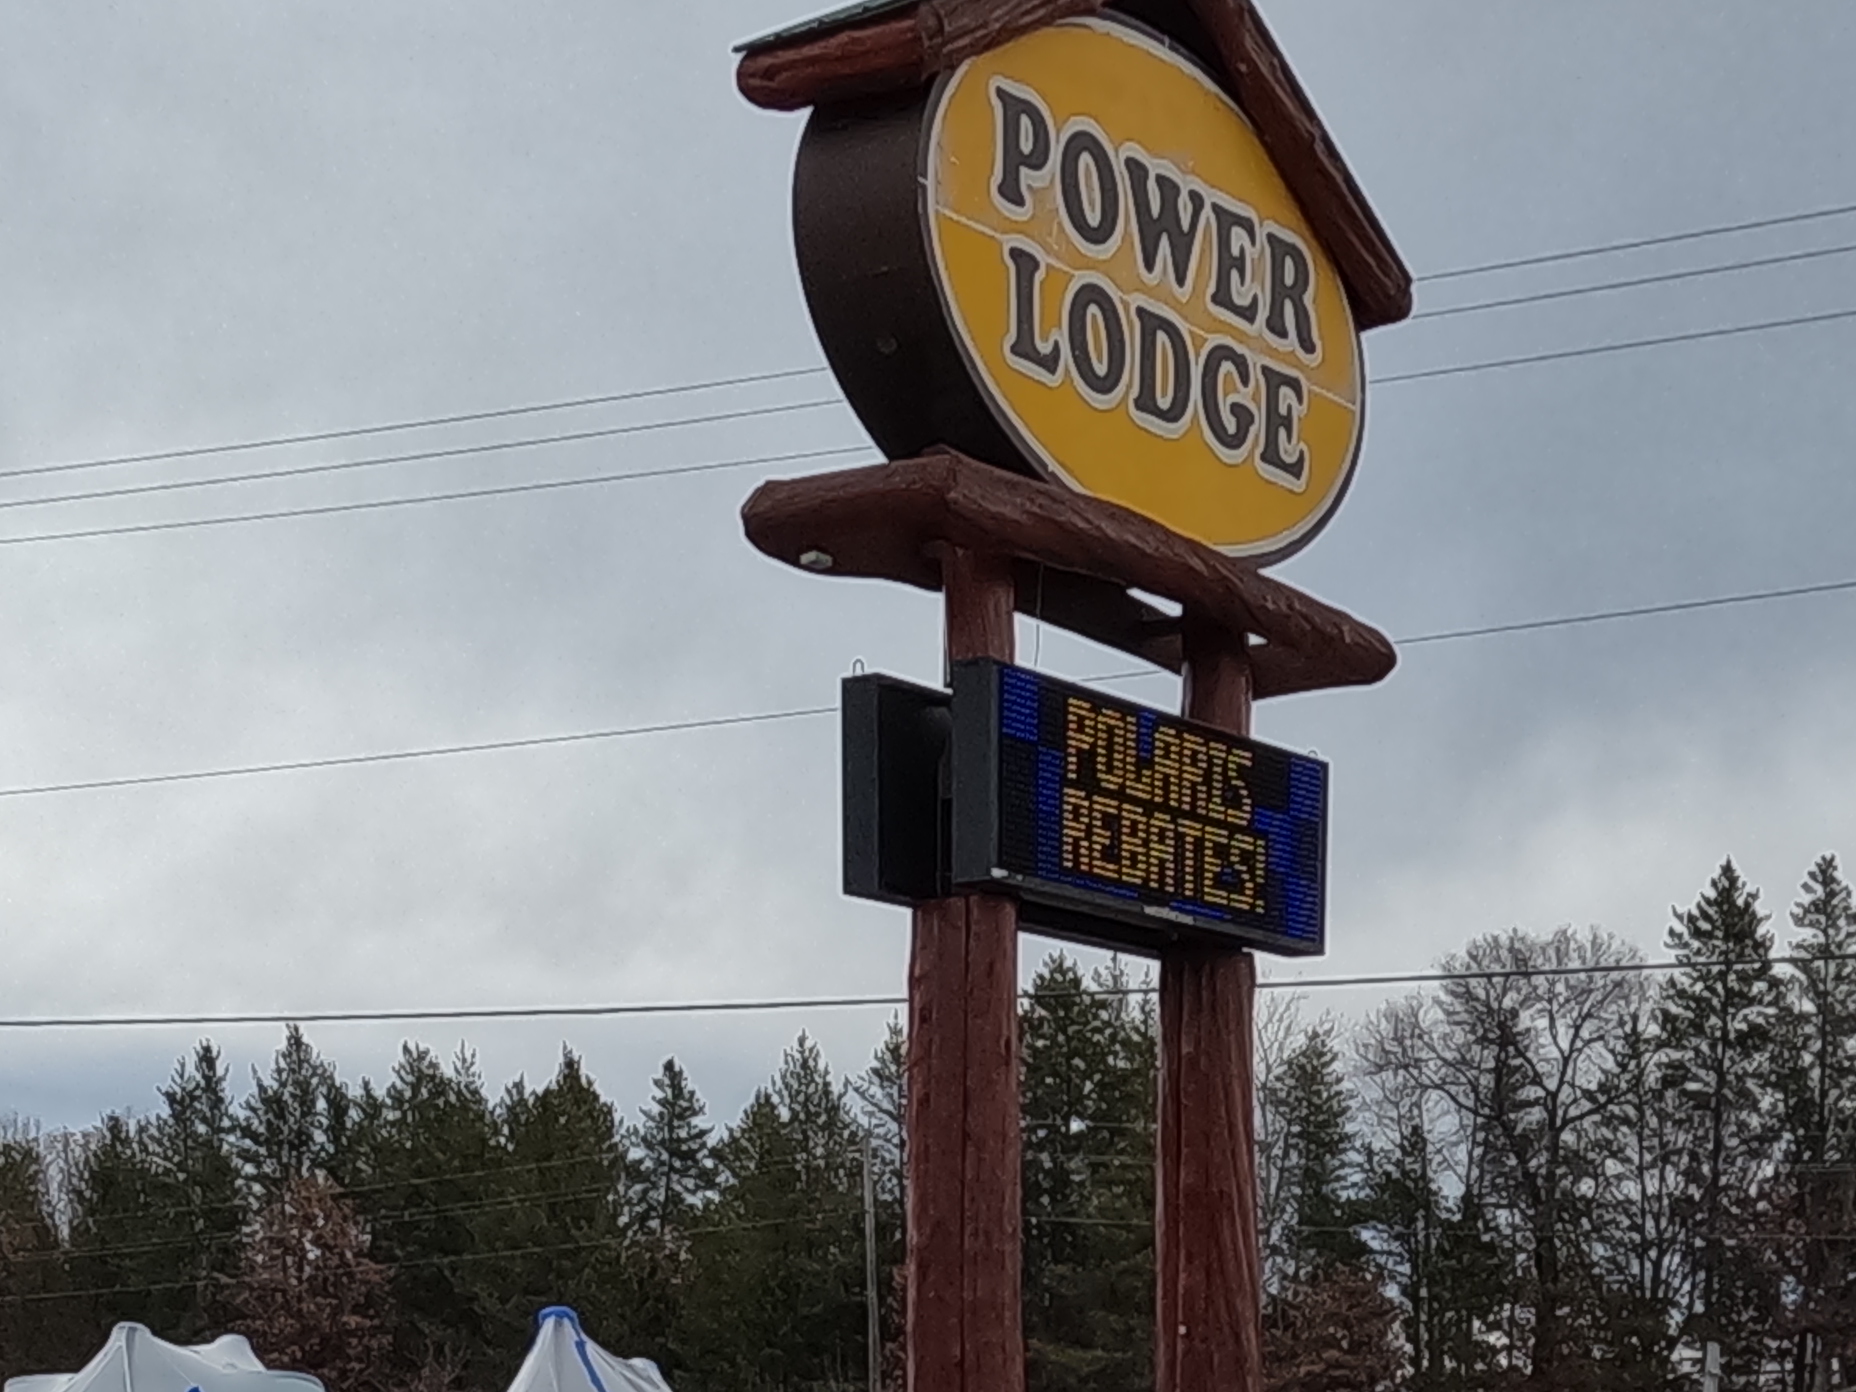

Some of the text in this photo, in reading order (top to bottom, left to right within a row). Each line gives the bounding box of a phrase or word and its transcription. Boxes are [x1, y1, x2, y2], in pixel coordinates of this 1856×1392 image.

[993, 82, 1319, 358] POWER
[1006, 243, 1308, 484] LODGE
[1061, 786, 1266, 914] REBATES!
[1065, 697, 1254, 827] POLARIS
